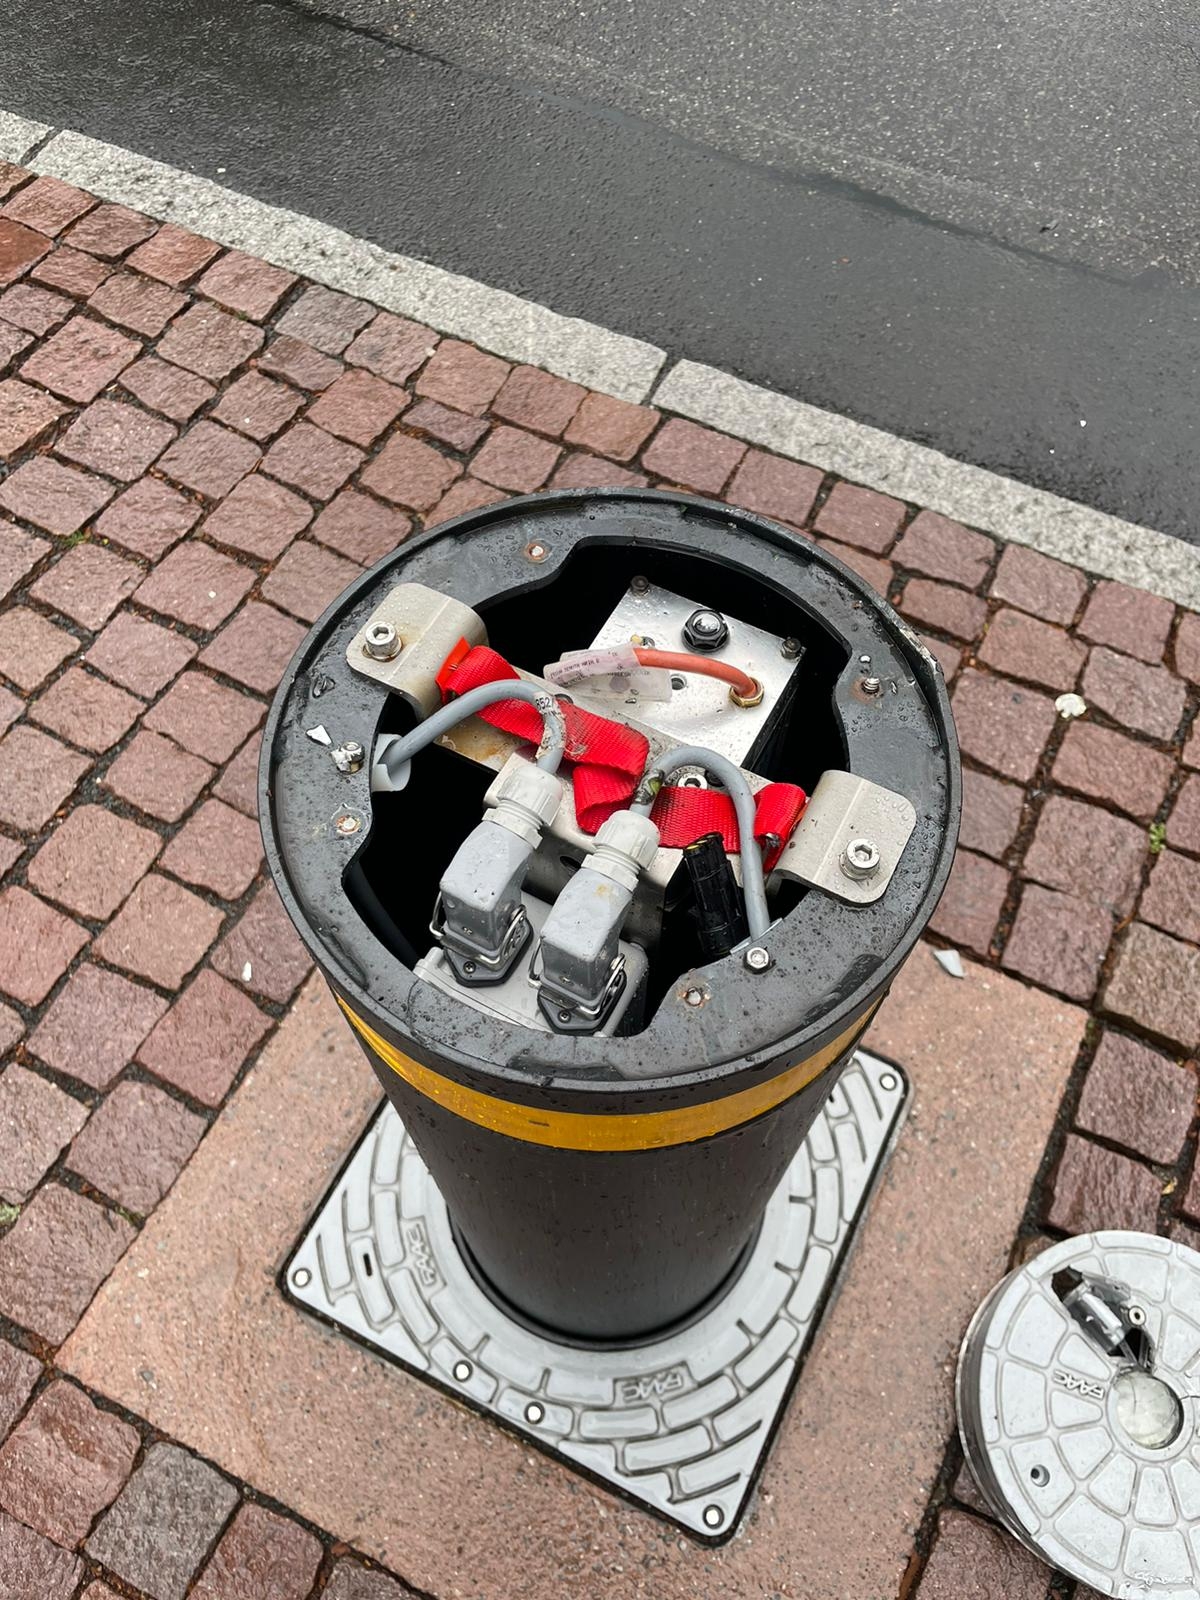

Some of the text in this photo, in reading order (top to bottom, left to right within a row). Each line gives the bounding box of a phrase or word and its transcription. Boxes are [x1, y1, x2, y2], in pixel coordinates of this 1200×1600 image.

[406, 1223, 437, 1288] FAAC
[621, 1371, 684, 1403] FAAC
[1052, 1368, 1106, 1401] FAAC
